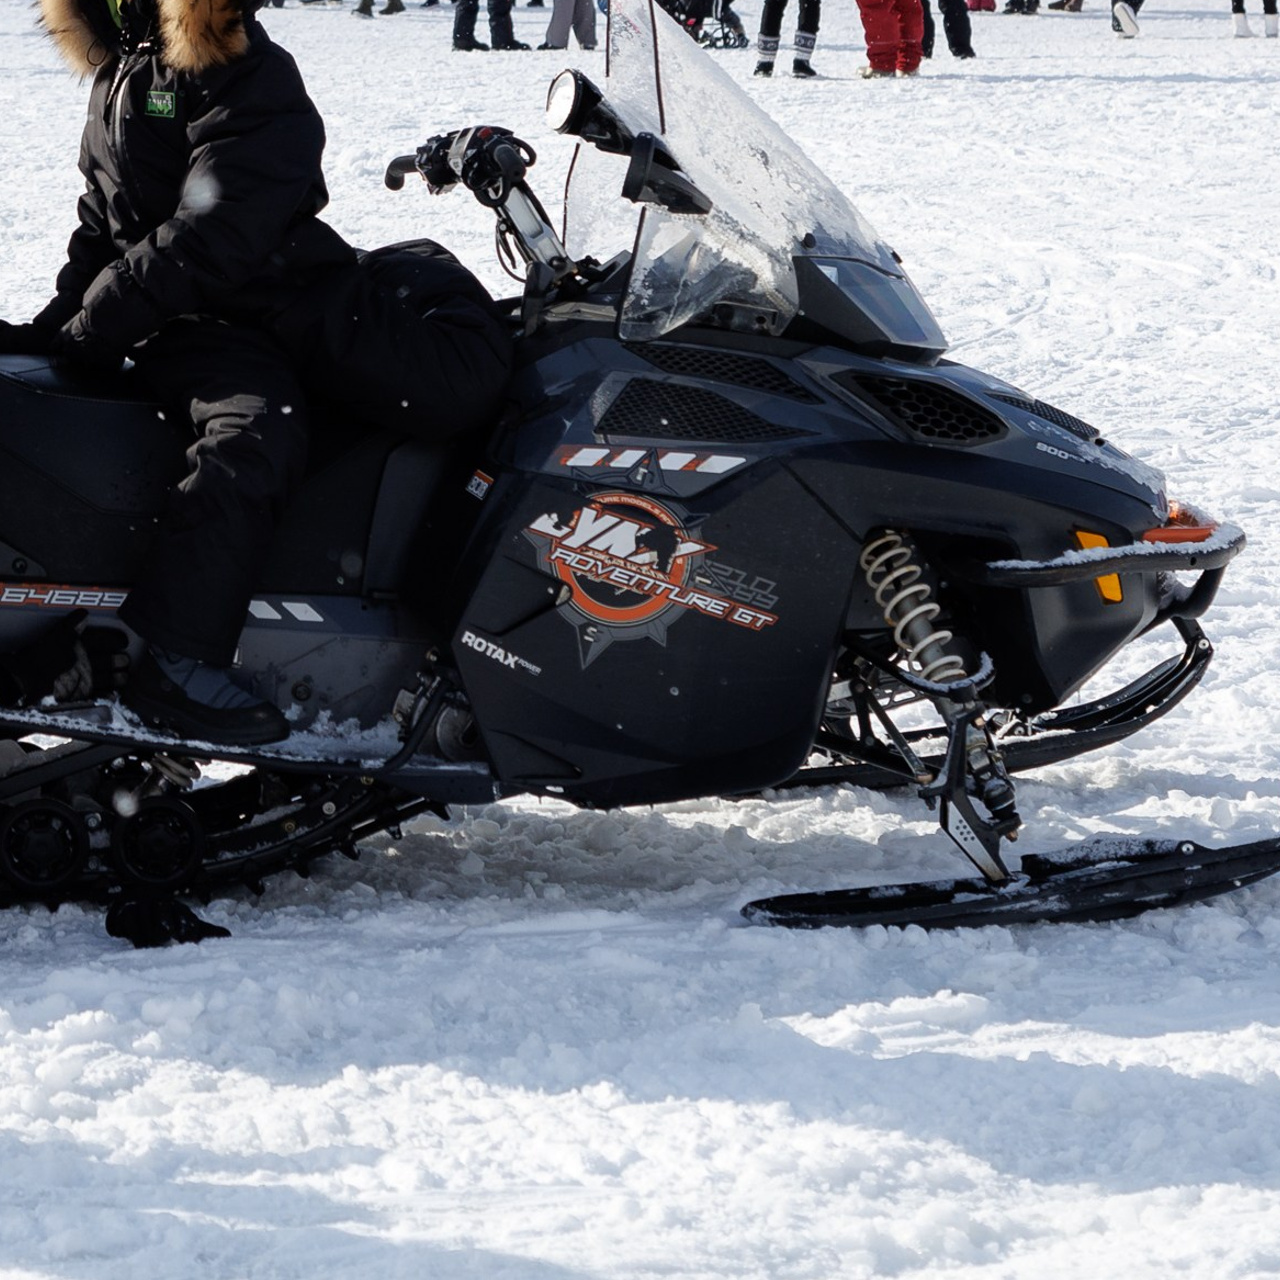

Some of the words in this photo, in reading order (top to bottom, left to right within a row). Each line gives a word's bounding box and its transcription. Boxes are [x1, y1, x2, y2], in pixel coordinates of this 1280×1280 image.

[549, 547, 731, 616] ADVENTURE
[732, 606, 776, 628] GT
[461, 630, 519, 670] ROTAX
